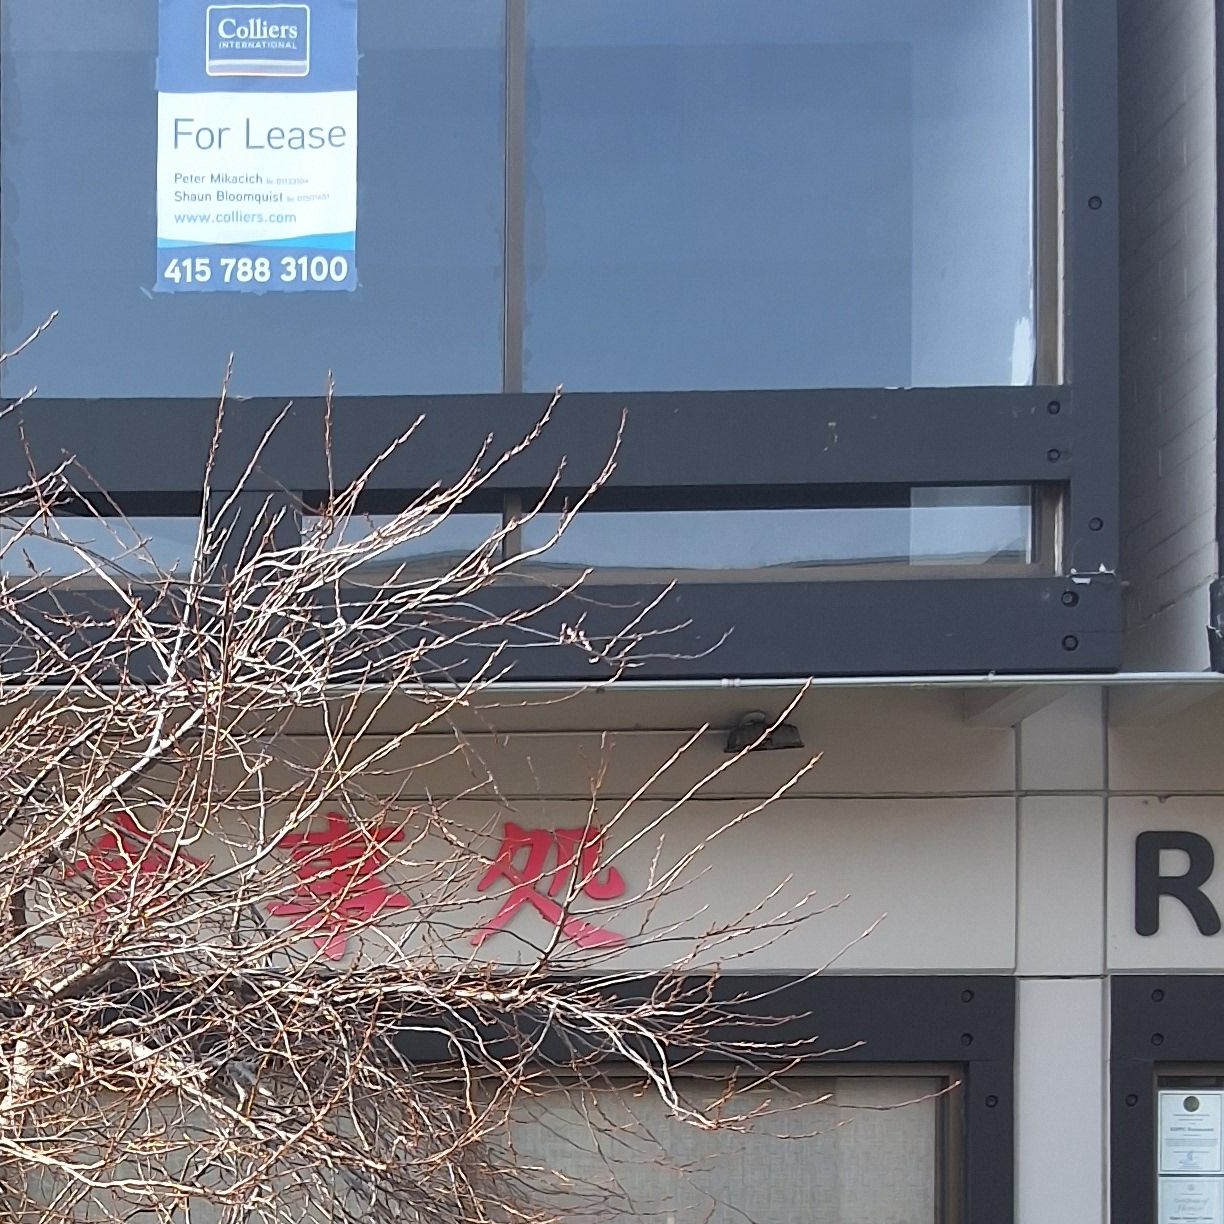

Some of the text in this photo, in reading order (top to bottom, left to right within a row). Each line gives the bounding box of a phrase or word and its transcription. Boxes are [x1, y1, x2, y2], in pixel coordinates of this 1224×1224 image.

[218, 18, 298, 39] Colliers
[218, 41, 297, 50] INTERNATIONAL
[174, 118, 347, 150] For Lease
[174, 173, 206, 185] Peter
[210, 172, 263, 185] Mikacich
[174, 190, 212, 202] Shaun
[216, 190, 283, 204] Bloomquist
[174, 210, 297, 224] www.colliers.com
[164, 256, 348, 284] 415 788 3100
